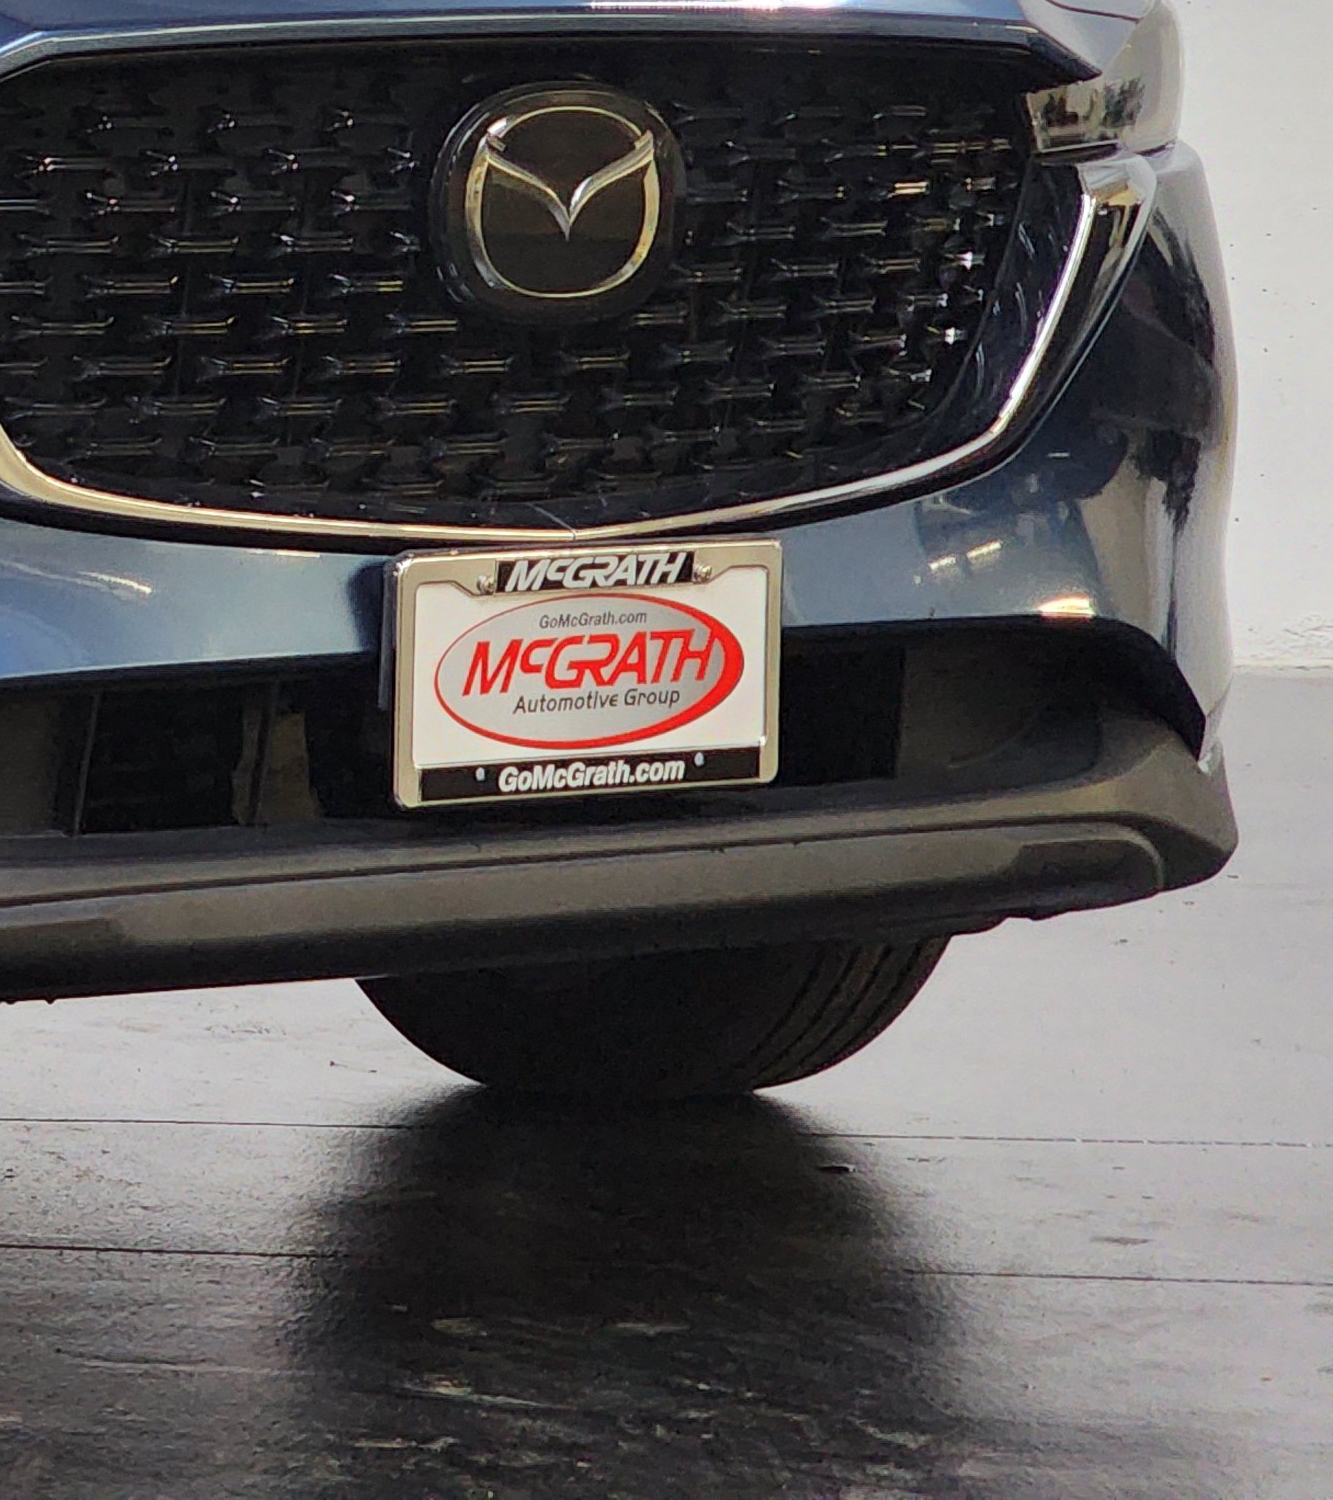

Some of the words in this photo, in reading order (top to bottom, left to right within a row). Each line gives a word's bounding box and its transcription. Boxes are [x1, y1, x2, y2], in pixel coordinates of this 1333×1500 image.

[539, 612, 647, 629] GoMcGrath.com
[513, 691, 619, 714] Automotive
[624, 688, 680, 708] Group
[498, 761, 685, 792] GoMcGrath.com
